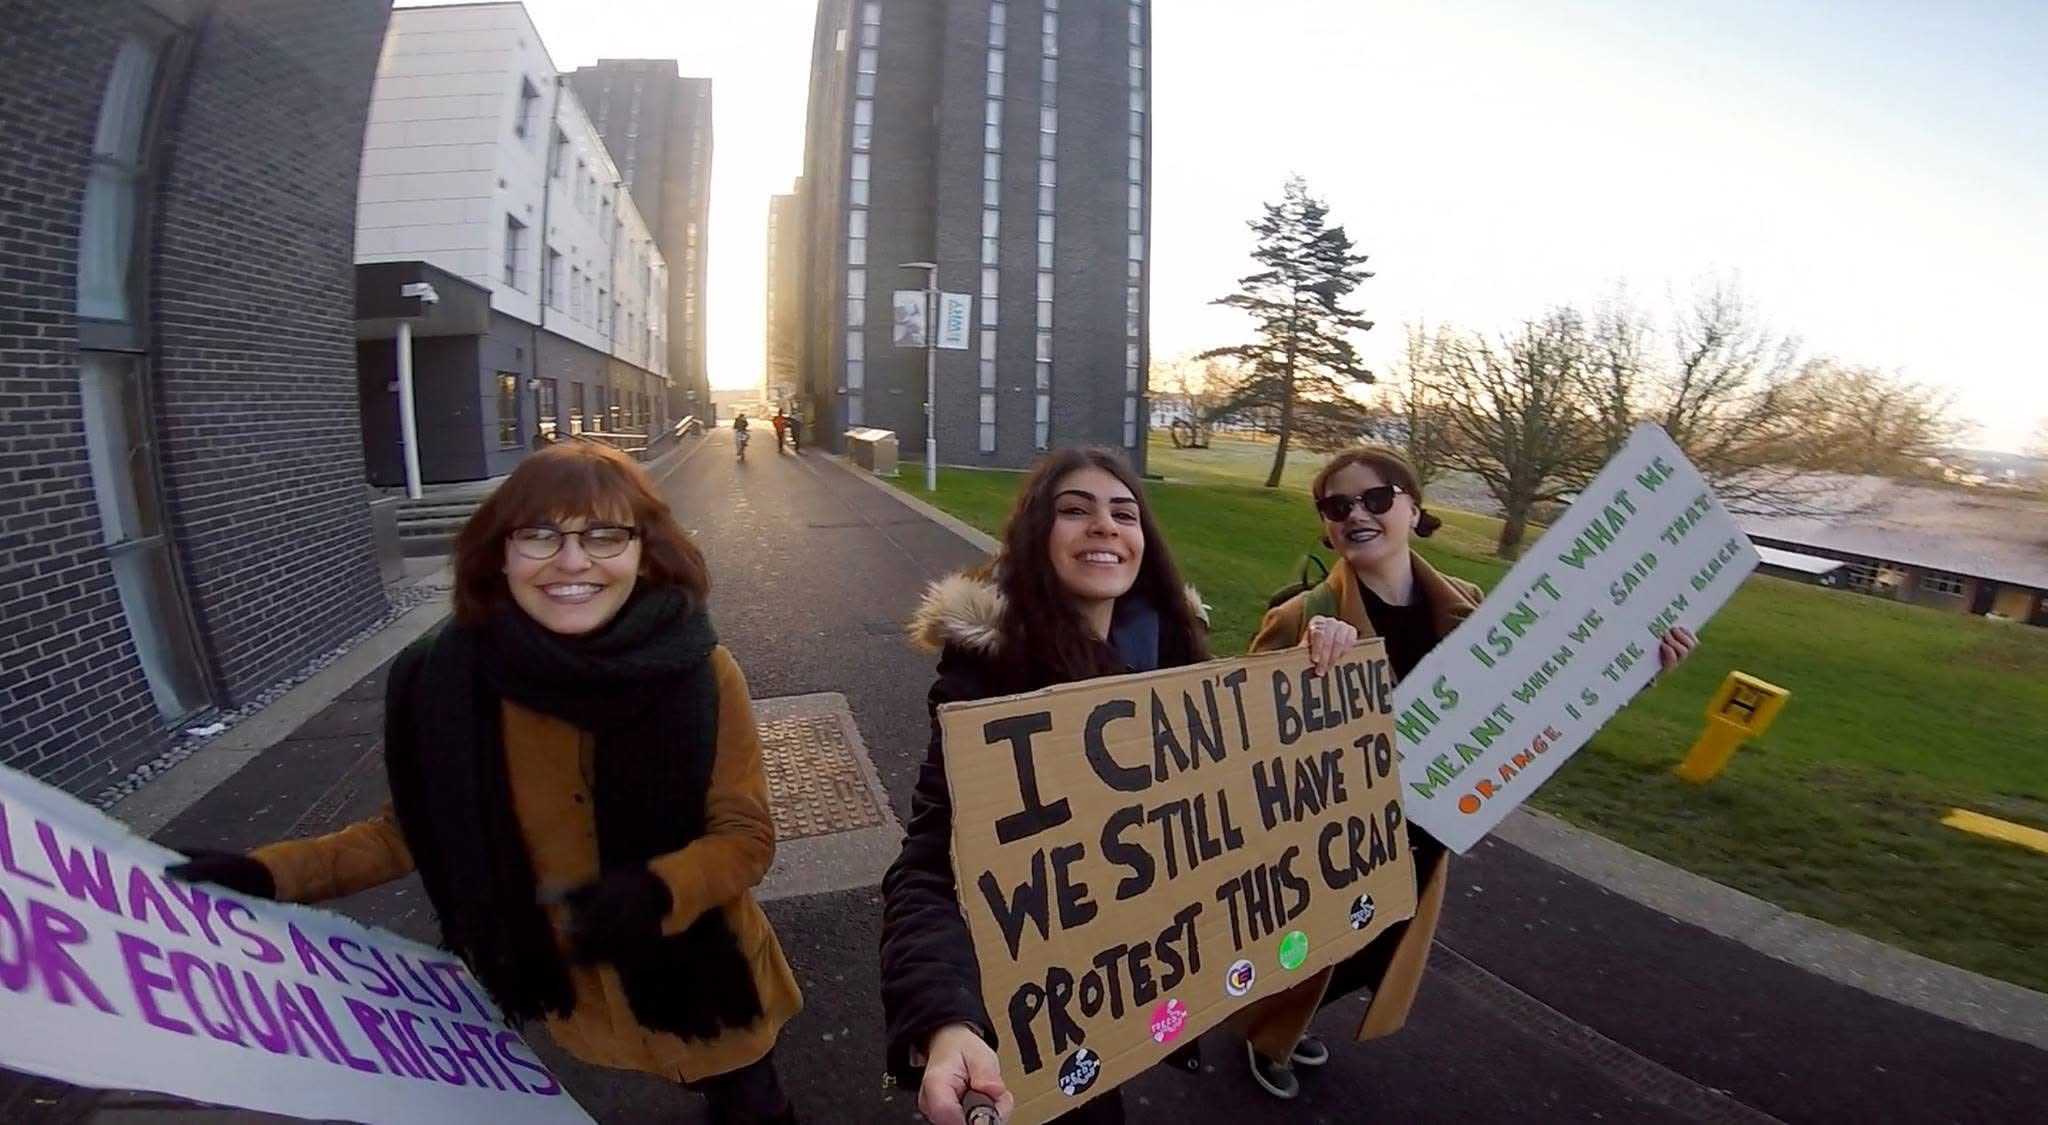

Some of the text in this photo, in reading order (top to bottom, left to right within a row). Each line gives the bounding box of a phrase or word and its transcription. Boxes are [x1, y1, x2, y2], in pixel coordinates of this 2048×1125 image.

[1395, 456, 1675, 762] HIS ISN'T WHAT WE
[1409, 494, 1712, 799] MEANT WHEN WE SAID THAT
[1458, 539, 1741, 815] ORANGE IS THE NEW BLACK
[1721, 685, 1768, 724] H
[978, 733, 1391, 960] WE STILL HAVE TO
[984, 659, 1392, 844] I CAN'T BELIEVE
[0, 803, 492, 1022] LWAYS A SLUT
[0, 888, 562, 1096] OR EQUAL RIGHTS
[1008, 800, 1402, 1074] PROTEST THIS CRAP
